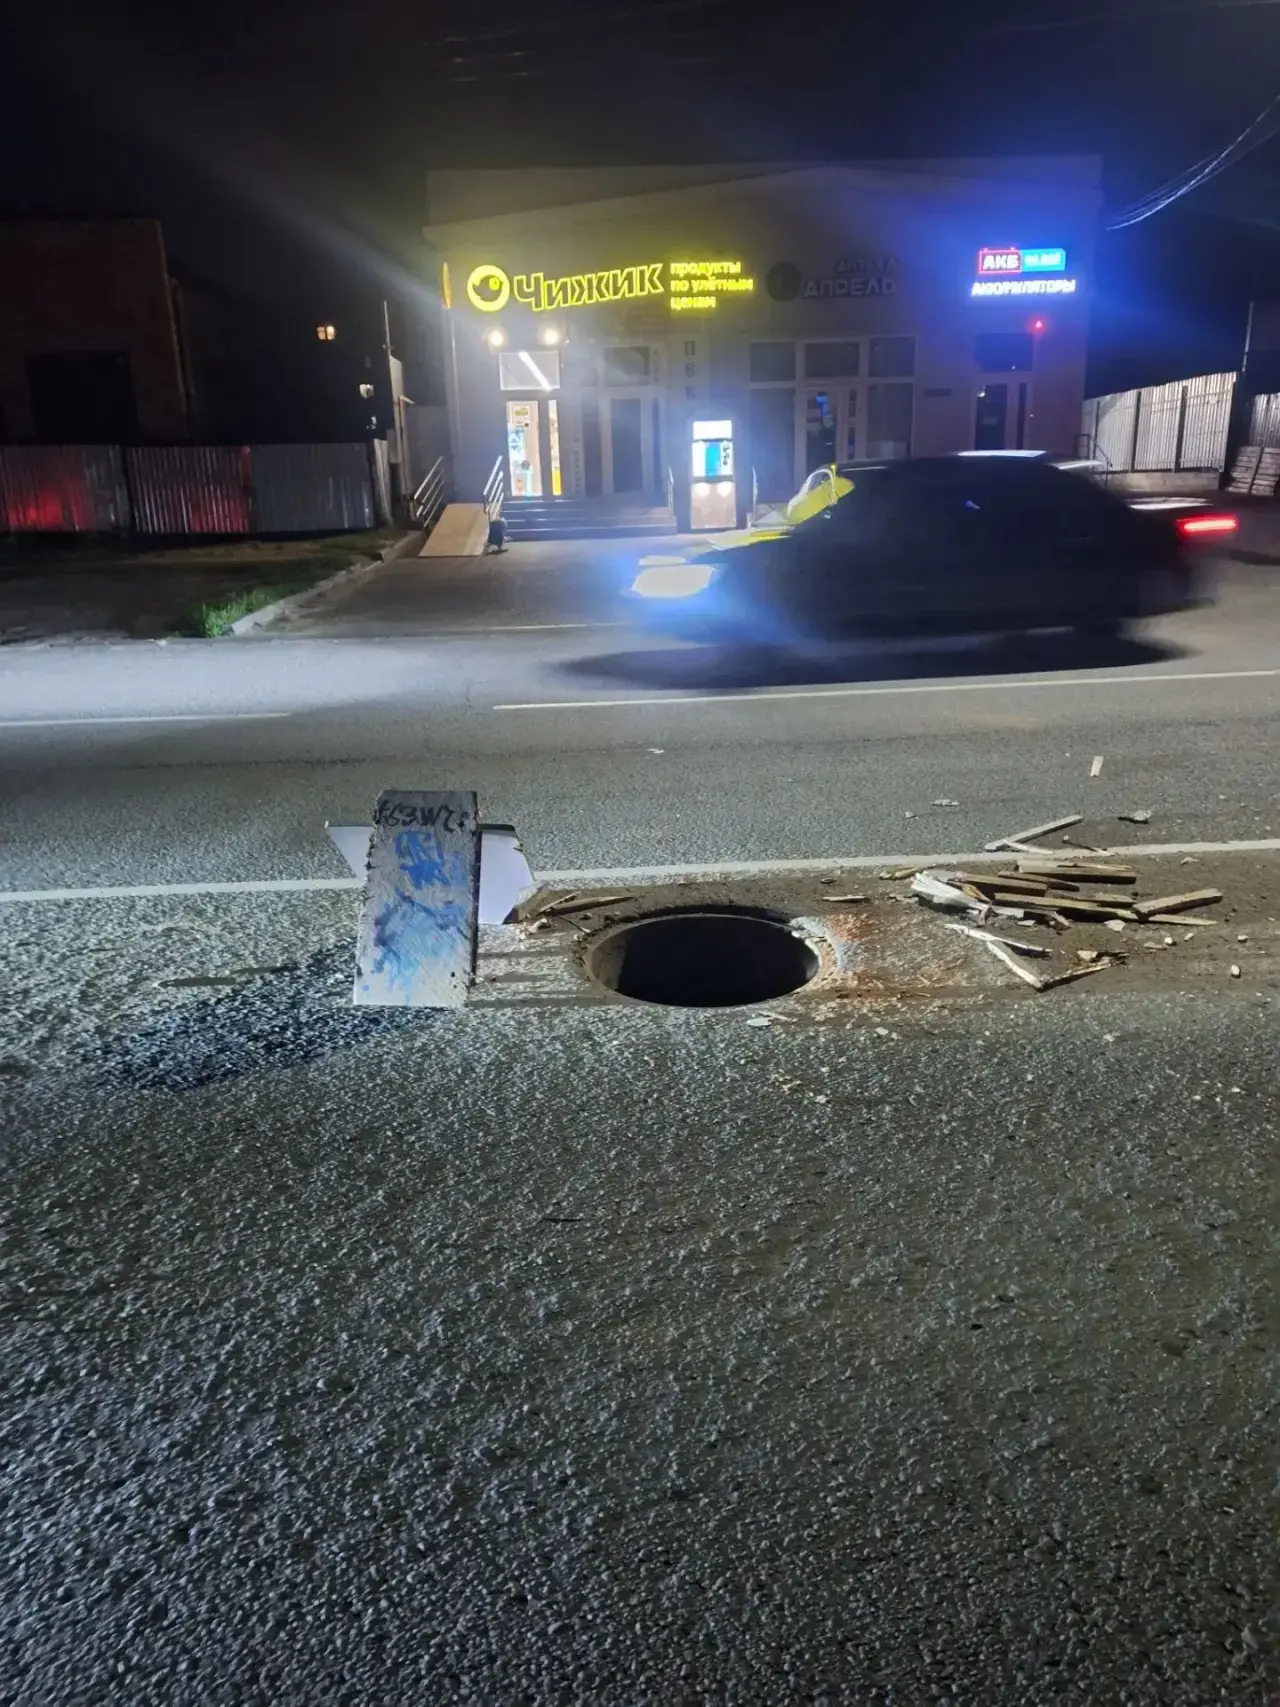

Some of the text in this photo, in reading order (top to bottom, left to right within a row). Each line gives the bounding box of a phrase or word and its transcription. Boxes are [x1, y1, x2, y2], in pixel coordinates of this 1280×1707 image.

[983, 254, 1019, 270] АКБ
[670, 262, 741, 277] продукты
[670, 280, 690, 292] по
[670, 296, 717, 310] ценам
